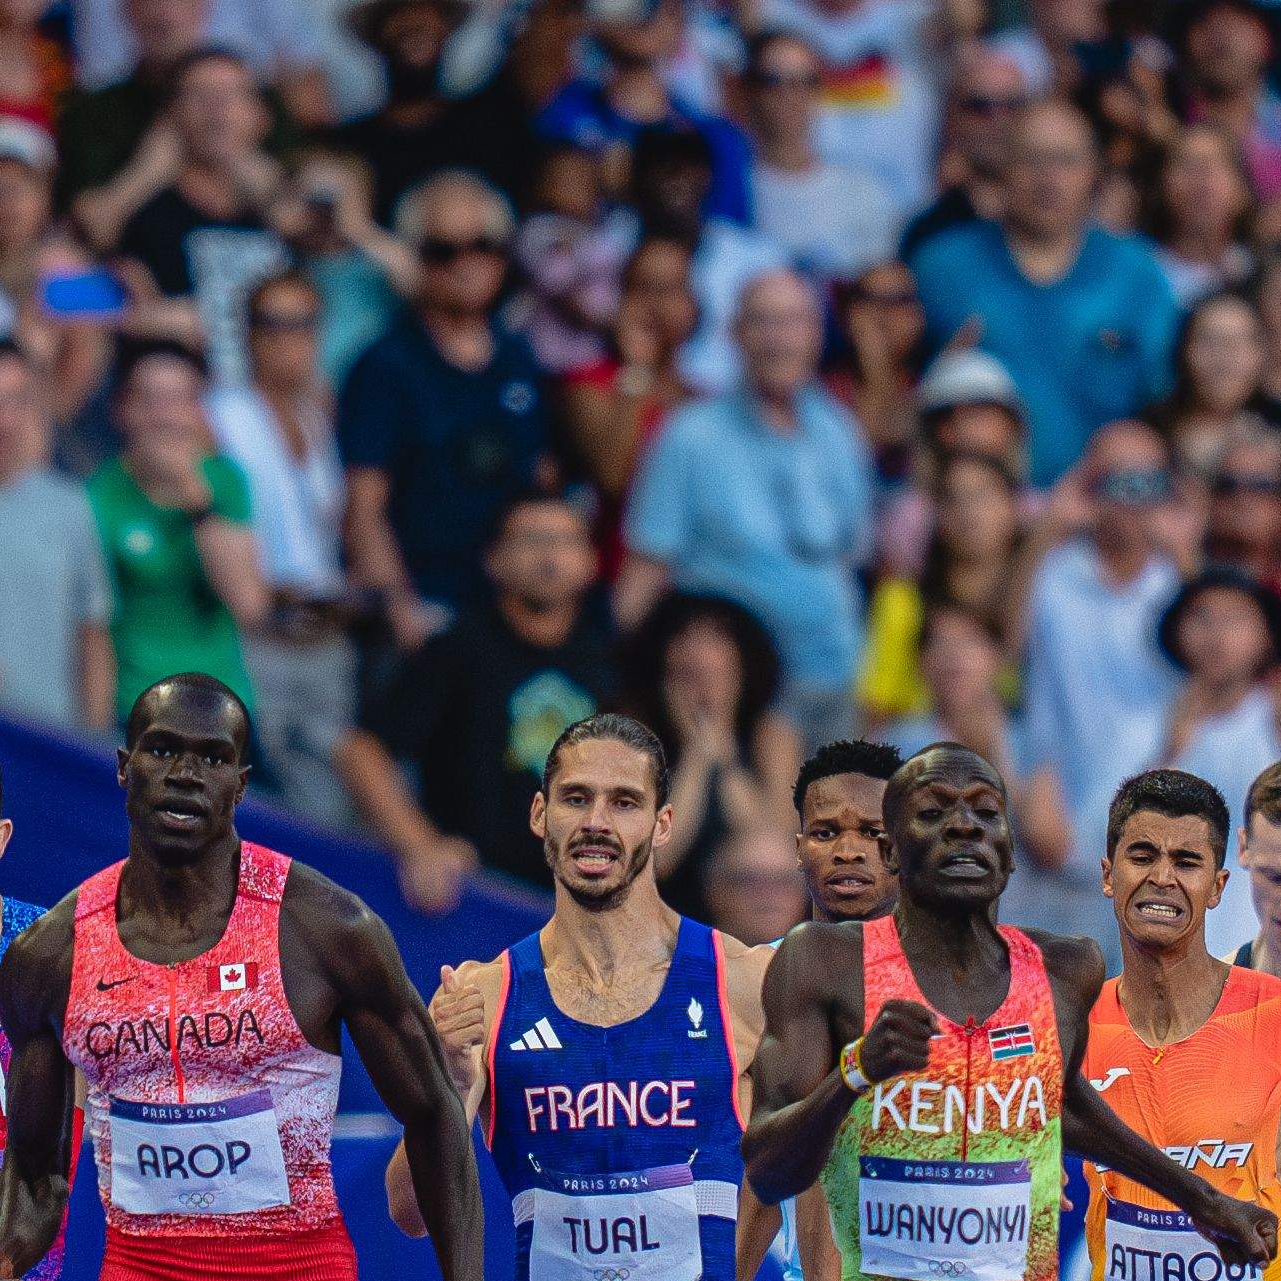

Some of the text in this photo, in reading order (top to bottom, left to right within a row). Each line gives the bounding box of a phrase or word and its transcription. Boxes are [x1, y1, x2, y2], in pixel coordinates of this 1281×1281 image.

[86, 1009, 265, 1058] CANADA
[142, 1106, 227, 1119] PARIS 2024
[524, 1080, 698, 1132] FRANCE
[871, 1076, 1047, 1134] KENYA
[137, 1140, 251, 1180] AROP
[904, 1165, 995, 1180] PARIS 2024
[563, 1175, 649, 1190] PARIS 2024
[563, 1214, 661, 1254] TUAL
[866, 1200, 1027, 1245] WANYONYI
[1136, 1210, 1173, 1226] PARIS
